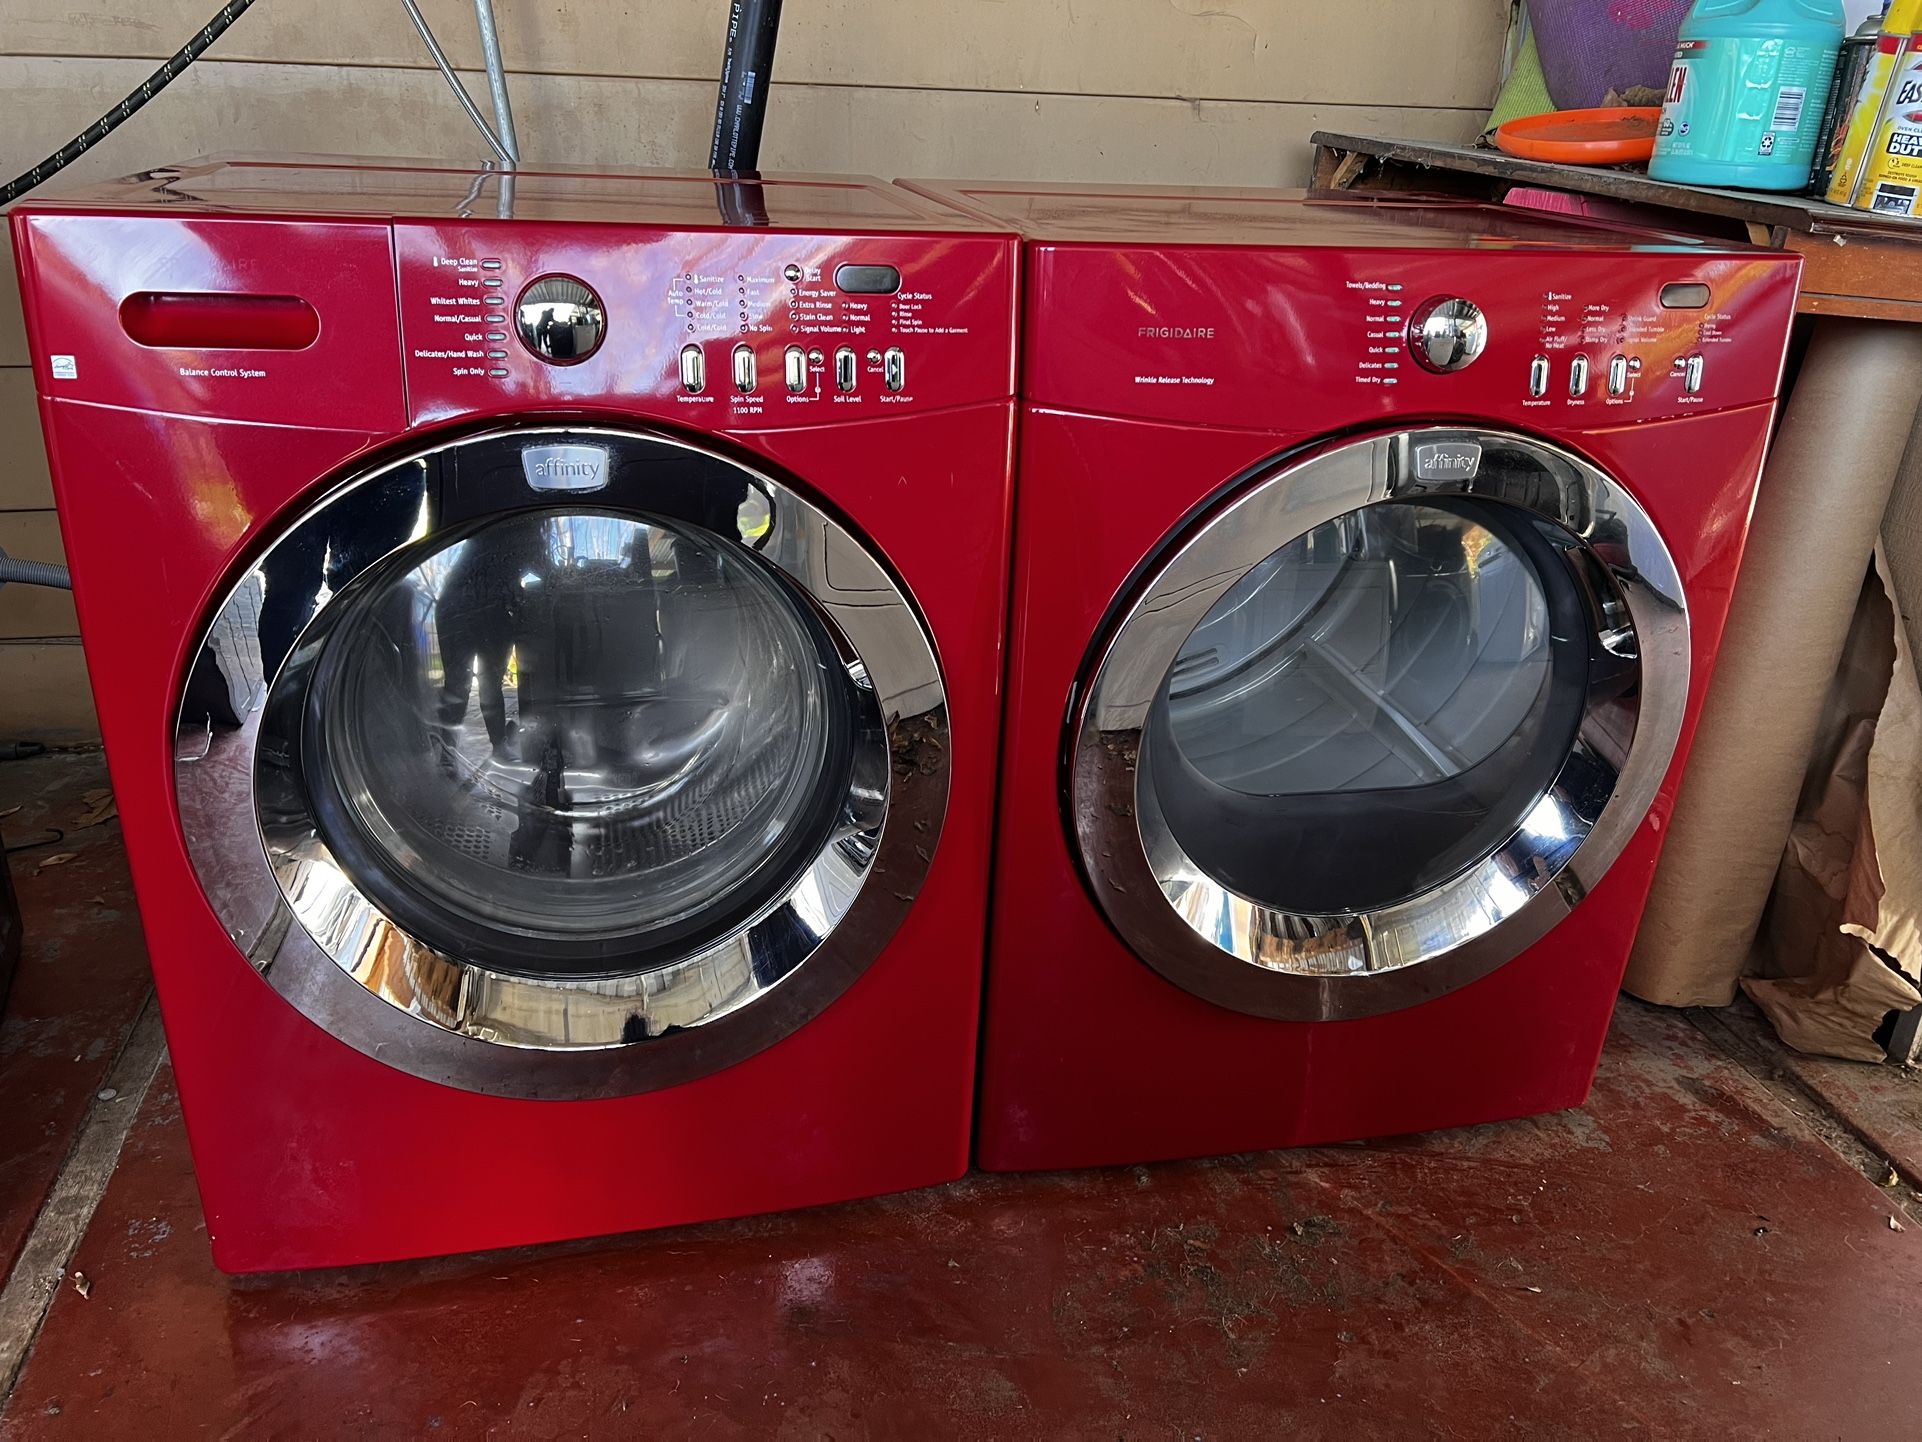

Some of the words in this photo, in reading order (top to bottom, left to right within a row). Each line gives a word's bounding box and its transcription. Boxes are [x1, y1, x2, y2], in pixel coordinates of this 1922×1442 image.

[700, 274, 724, 282] Sanitize
[458, 279, 478, 287] Heavy
[1346, 281, 1386, 290] Towels/Bedding
[694, 288, 722, 296] Hot/Cold
[898, 292, 912, 300] Cycle
[430, 297, 456, 305] Whitest
[850, 302, 868, 310] Heavy
[1548, 304, 1560, 312] High
[1601, 304, 1610, 312] Dry
[434, 315, 482, 324] Normal/Casual
[800, 326, 818, 334] Signal
[850, 326, 866, 334] Light
[1138, 327, 1215, 338] FRIGIDAIRE
[464, 334, 482, 342] Quick
[415, 350, 465, 358] Delicates/Hand
[180, 368, 208, 376] Balance
[210, 368, 238, 377] Control
[239, 369, 266, 378] System
[453, 368, 468, 376] Spin
[470, 368, 485, 376] Only
[1134, 376, 1157, 384] Wrinkle
[1158, 376, 1180, 384] Release
[1182, 376, 1214, 385] Technology
[1372, 376, 1381, 384] Dry
[676, 396, 714, 404] Temperature
[730, 396, 744, 404] Spin
[746, 396, 764, 404] Speed
[786, 396, 809, 404] Options
[880, 395, 914, 404] Start/Pause
[1606, 398, 1624, 406] Options
[1677, 396, 1704, 404] Start/Pause
[1424, 453, 1475, 472] affinity
[536, 457, 599, 480] affinity
